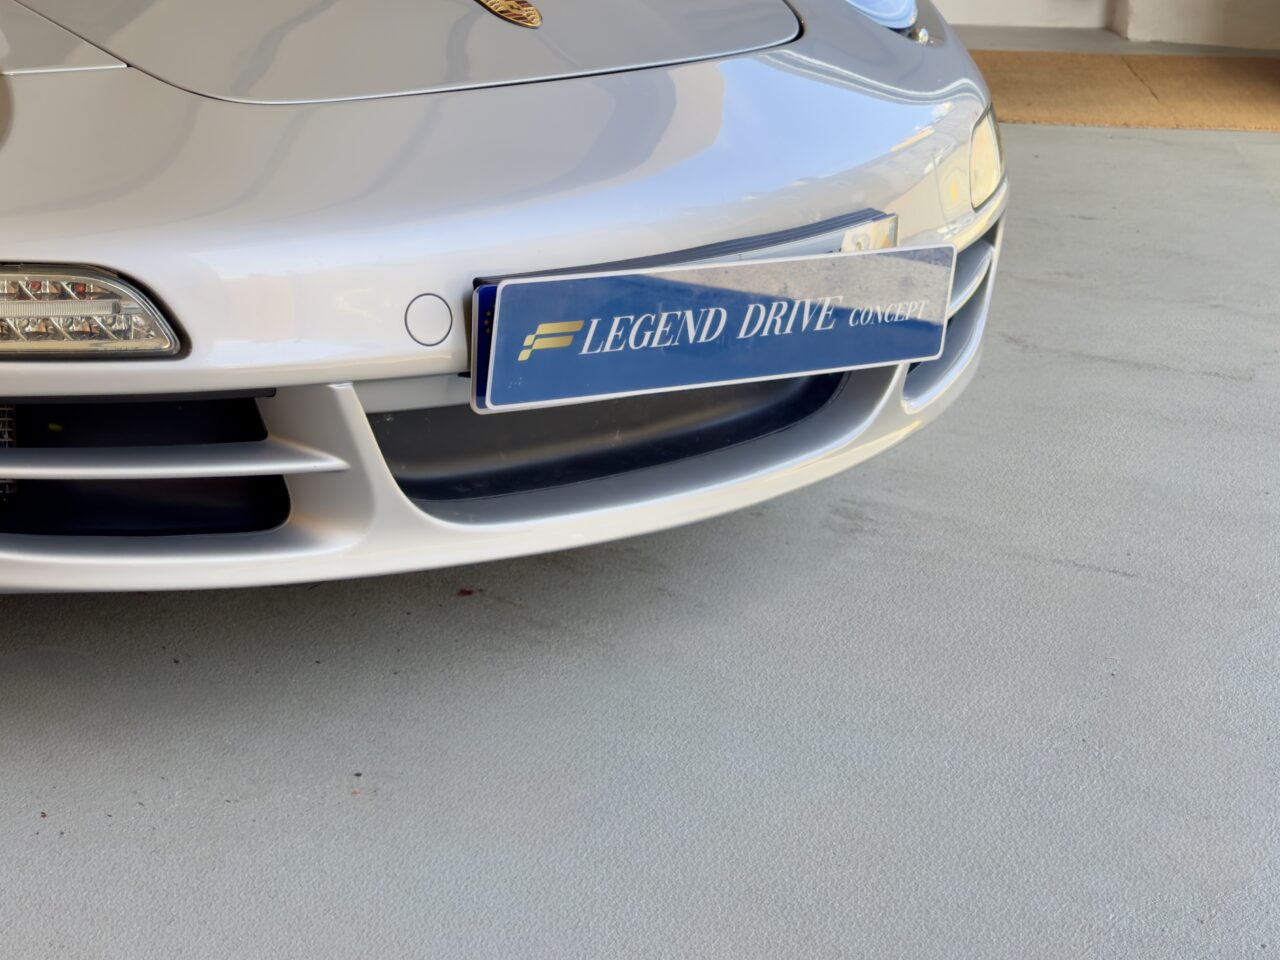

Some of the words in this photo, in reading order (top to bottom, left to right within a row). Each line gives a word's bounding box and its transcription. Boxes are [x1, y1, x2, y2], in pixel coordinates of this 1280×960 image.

[578, 306, 727, 357] LEGEND
[736, 294, 844, 340] DRIVE
[848, 299, 929, 329] CONCEPT
